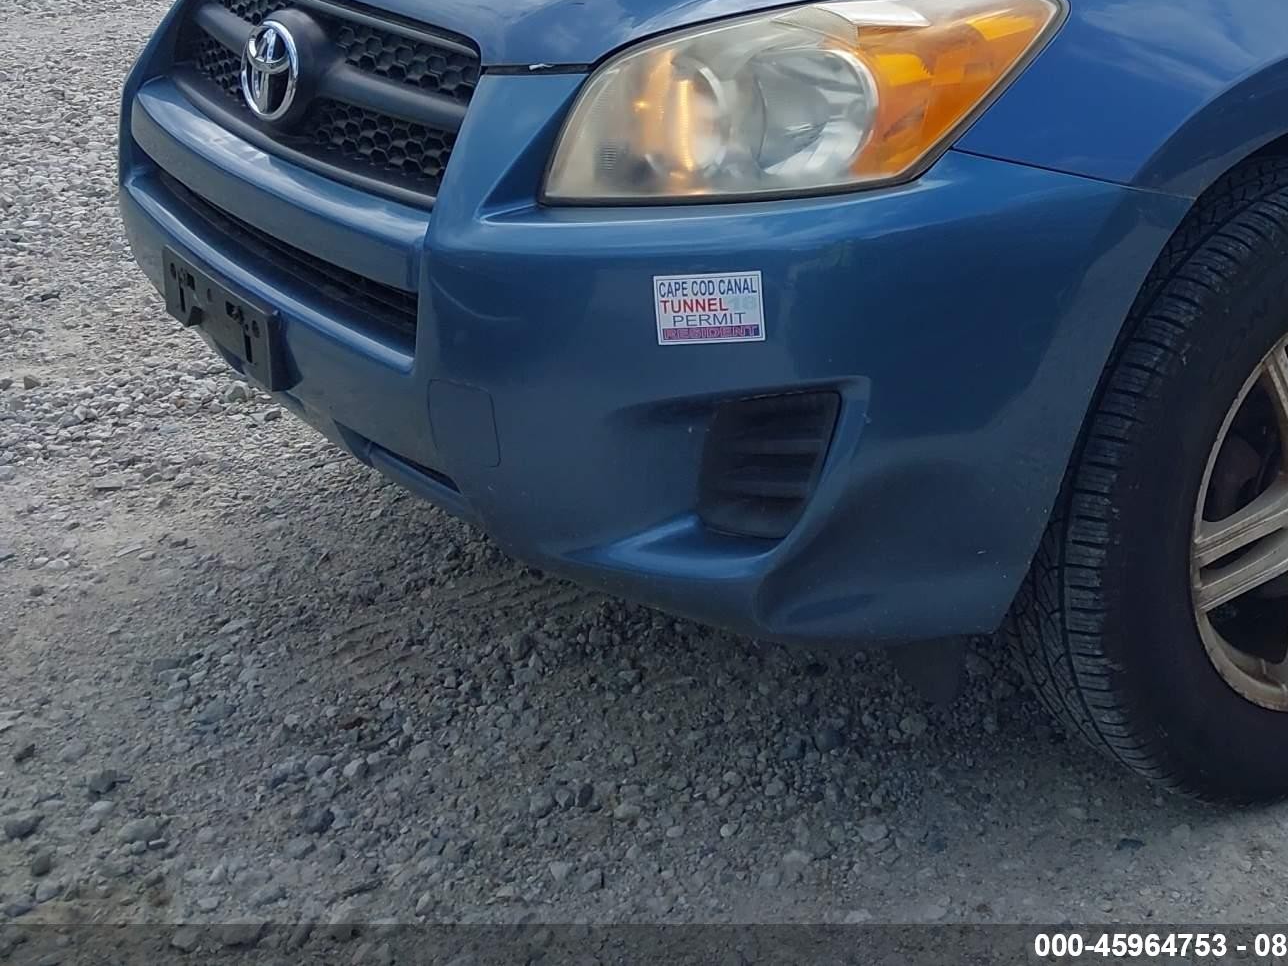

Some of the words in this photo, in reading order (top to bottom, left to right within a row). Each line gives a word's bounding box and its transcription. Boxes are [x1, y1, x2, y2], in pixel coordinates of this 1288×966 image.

[659, 281, 688, 298] CAPE
[691, 279, 716, 297] COD
[718, 277, 757, 295] CANAL
[660, 297, 729, 314] TUNNEL
[672, 312, 745, 327] PERMIT
